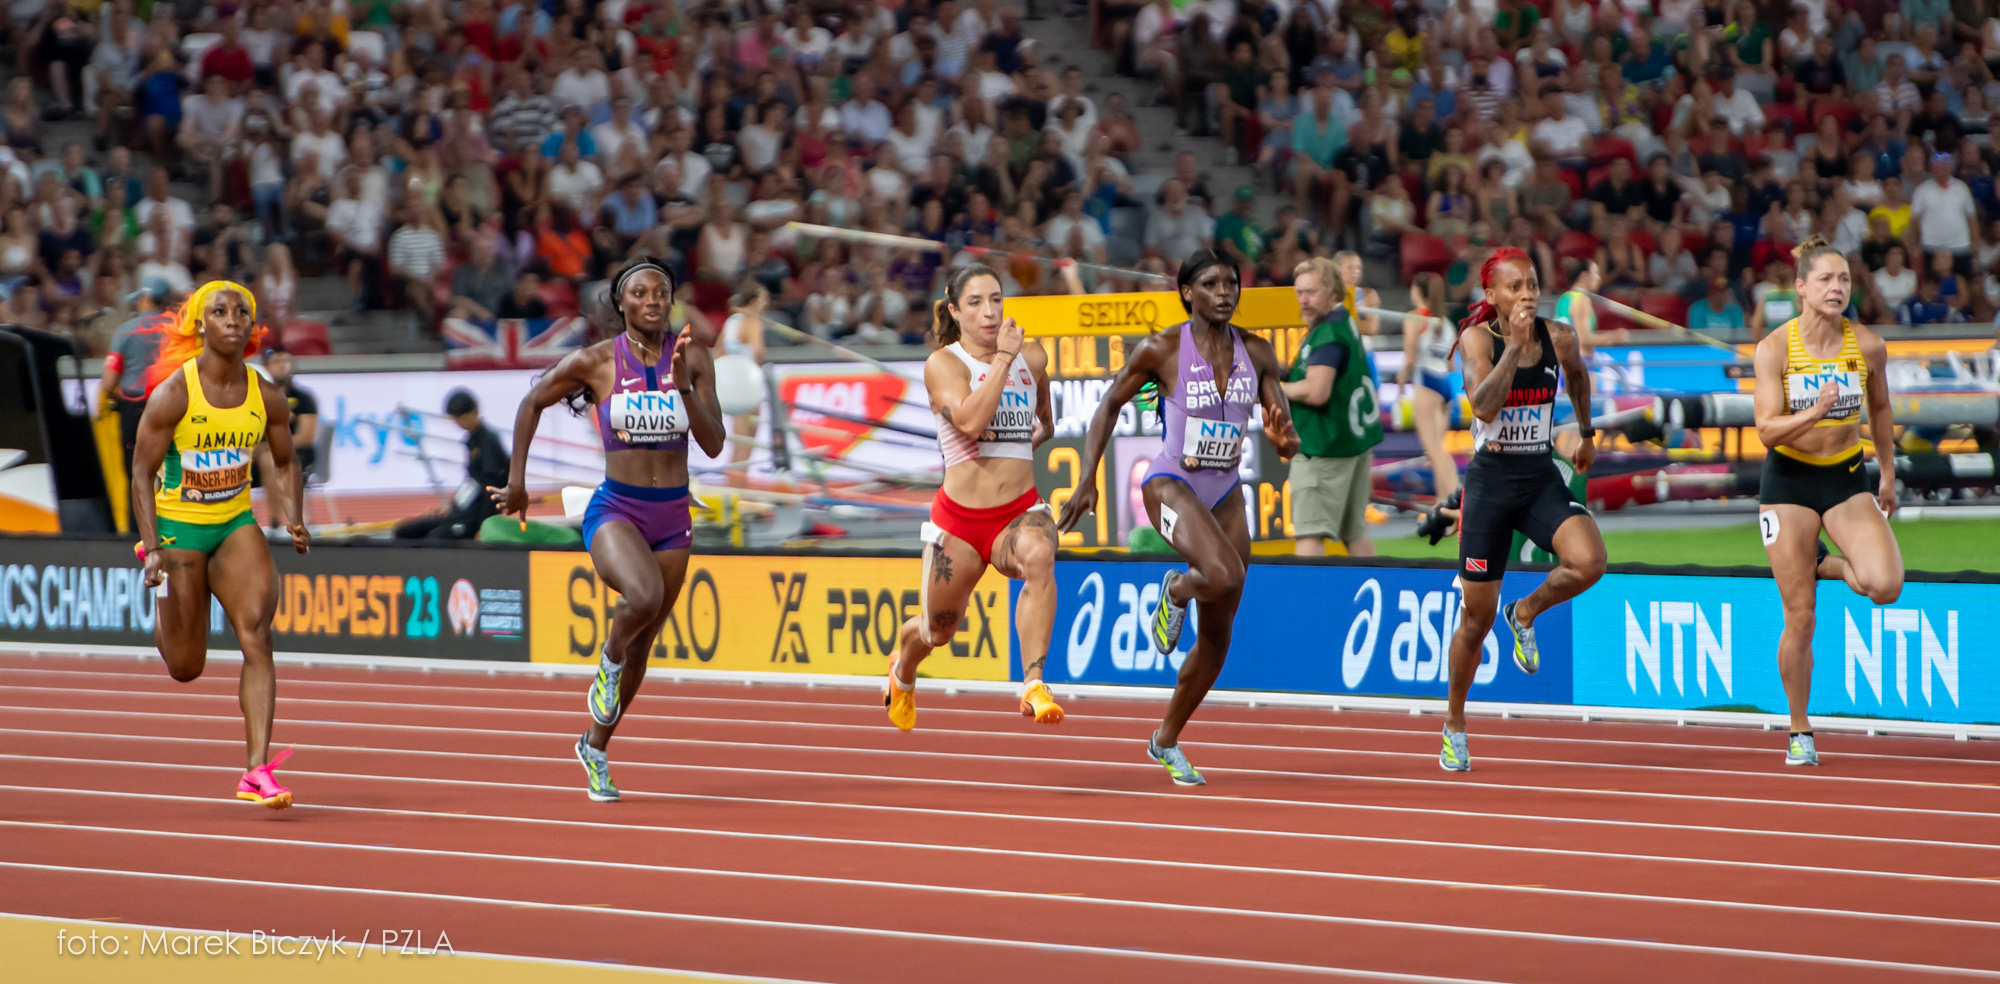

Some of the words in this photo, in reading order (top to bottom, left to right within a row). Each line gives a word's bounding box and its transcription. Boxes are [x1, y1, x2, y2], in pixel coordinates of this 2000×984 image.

[1078, 300, 1158, 327] SEIKO
[1186, 377, 1252, 396] GREAT
[1803, 373, 1849, 390] NTN
[626, 394, 674, 412] NTN
[1186, 390, 1255, 410] BRITAIN
[1506, 387, 1548, 401] RINIDAD
[624, 415, 676, 431] DAVIS
[990, 411, 1033, 428] WOBOD
[1501, 406, 1541, 423] NTN
[1201, 421, 1244, 440] NTN
[1498, 425, 1539, 441] AHYE
[1195, 440, 1238, 457] NEITA
[195, 448, 241, 469] NTN
[1763, 516, 1773, 539] 2
[272, 573, 403, 638] UDAPEST
[405, 575, 441, 639] 23
[1625, 599, 1732, 699] NTN
[1844, 606, 1959, 709] NTN
